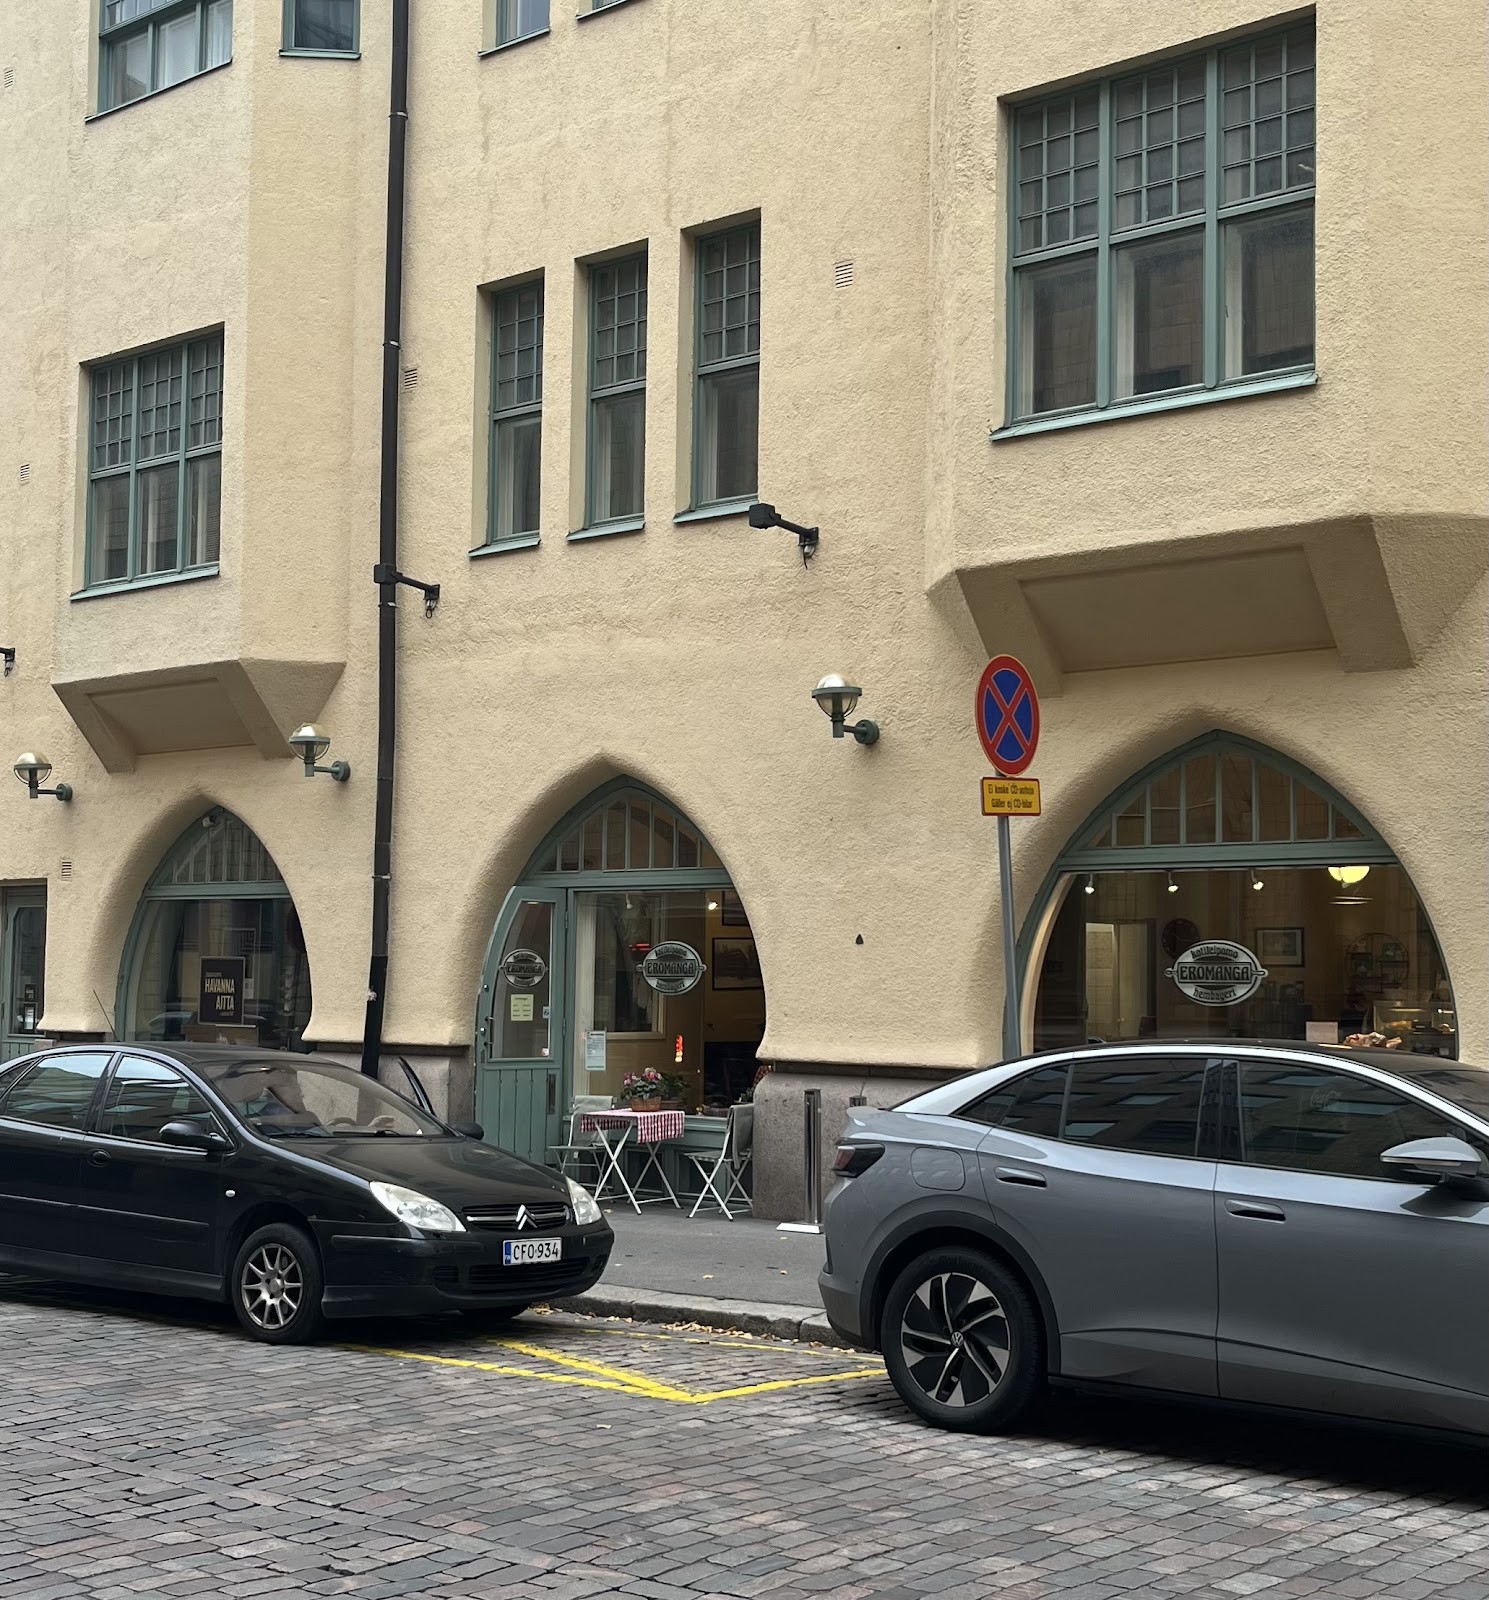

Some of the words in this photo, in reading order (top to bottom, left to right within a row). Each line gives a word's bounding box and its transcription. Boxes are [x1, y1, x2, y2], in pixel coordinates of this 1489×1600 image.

[647, 963, 694, 975] EROMANGA
[1180, 966, 1249, 980] EROMANGA
[204, 978, 235, 993] HAVANNA
[215, 995, 235, 1010] AITTA
[513, 1243, 558, 1260] CFO-934
